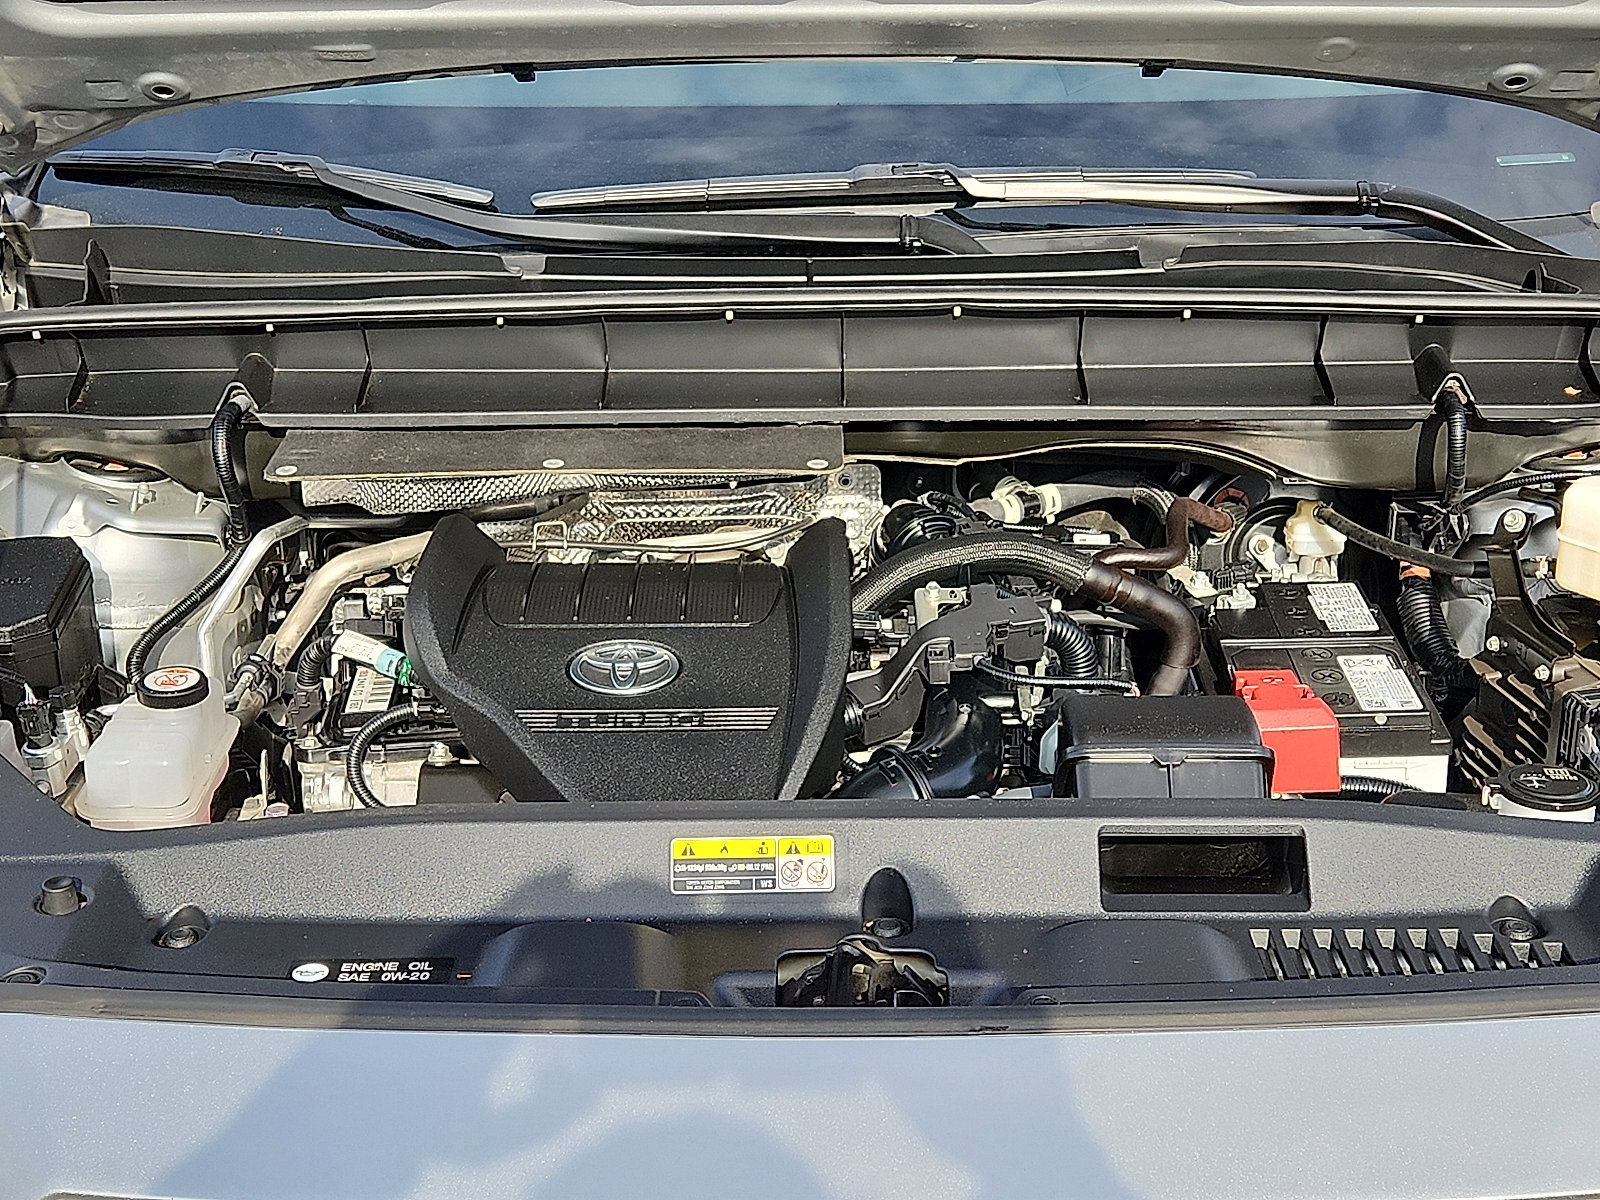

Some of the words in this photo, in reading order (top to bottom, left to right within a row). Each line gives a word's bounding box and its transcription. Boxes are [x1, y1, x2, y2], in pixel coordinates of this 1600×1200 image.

[558, 713, 703, 727] TURBO
[340, 961, 400, 972] ENGINE
[408, 961, 434, 971] OIL
[337, 972, 371, 982] SAE
[381, 971, 431, 981] 0W-20
